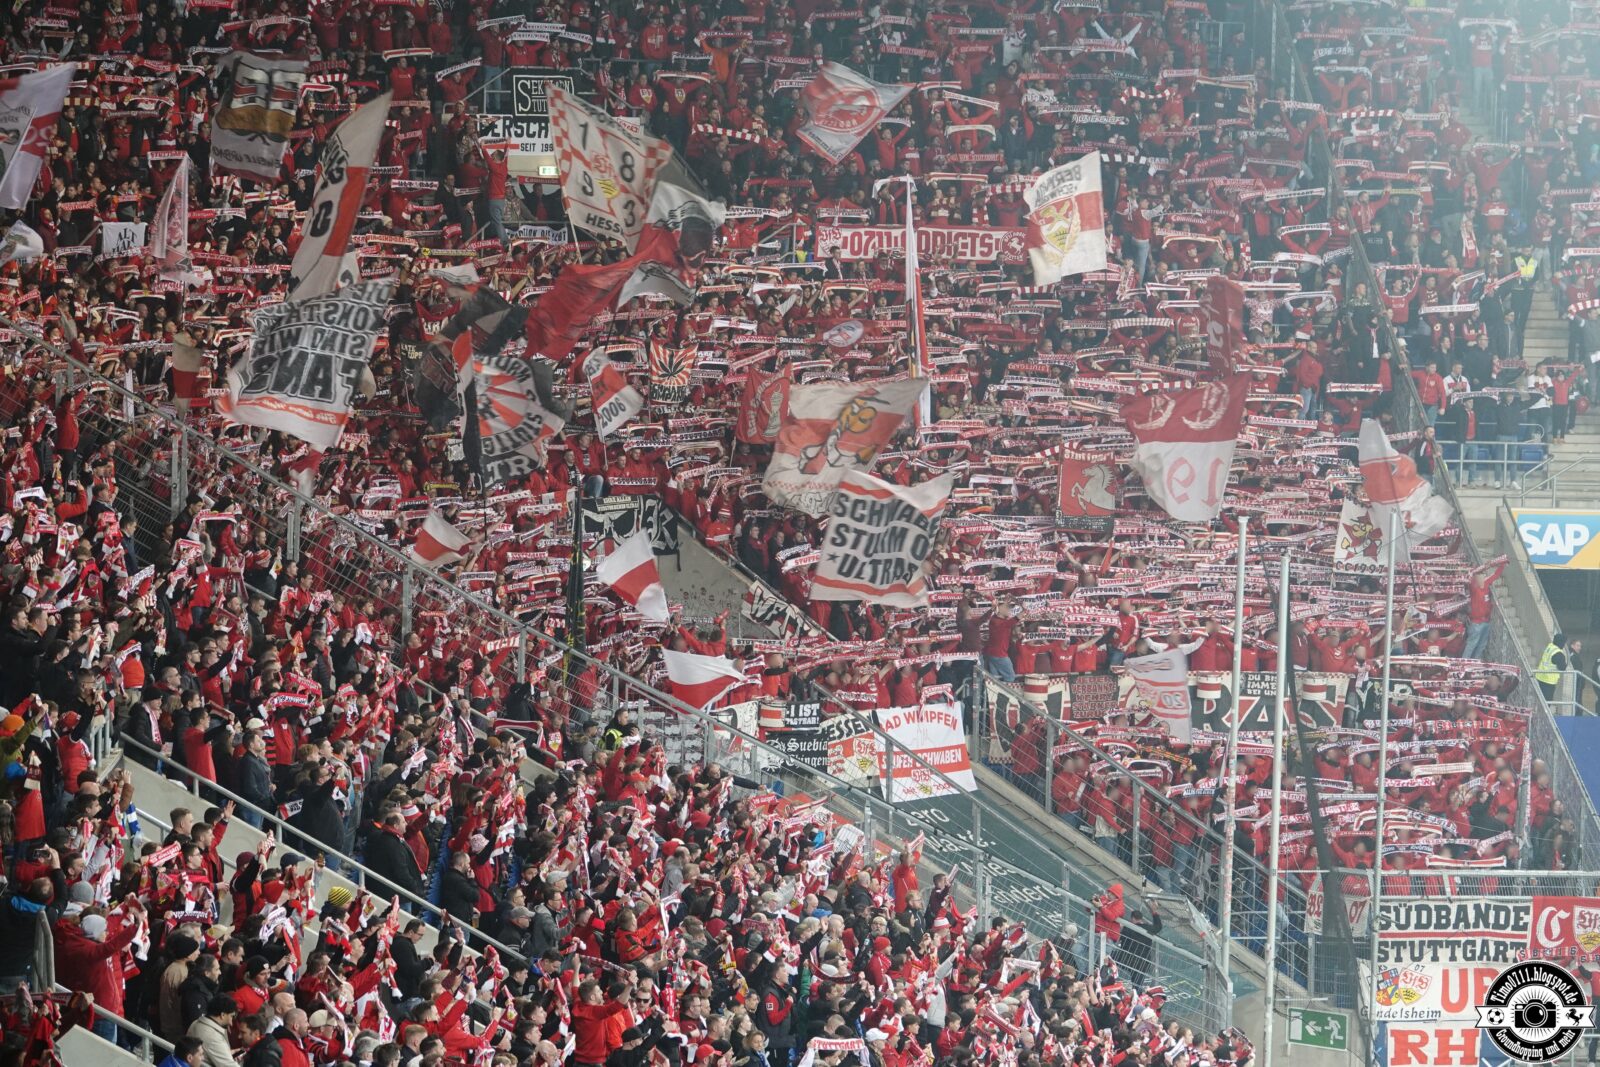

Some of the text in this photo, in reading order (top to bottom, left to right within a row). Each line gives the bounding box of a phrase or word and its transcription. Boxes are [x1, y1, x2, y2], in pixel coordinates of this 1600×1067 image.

[520, 143, 536, 152] SEIT
[579, 122, 587, 150] 1
[620, 151, 634, 183] 8
[623, 199, 635, 227] 3
[900, 230, 994, 259] DDICTS
[600, 397, 626, 429] 2006
[1519, 523, 1590, 556] SAP
[837, 555, 922, 588] ULTRAS
[799, 703, 820, 717] IST
[879, 710, 958, 734] BAD WIMPFEN
[1378, 902, 1530, 931] SÜDBANDE
[1376, 941, 1523, 964] STUTTGART
[1360, 1005, 1441, 1020] Gndelsheim
[815, 1039, 865, 1050] STUTTGART
[1389, 1028, 1480, 1067] RH
